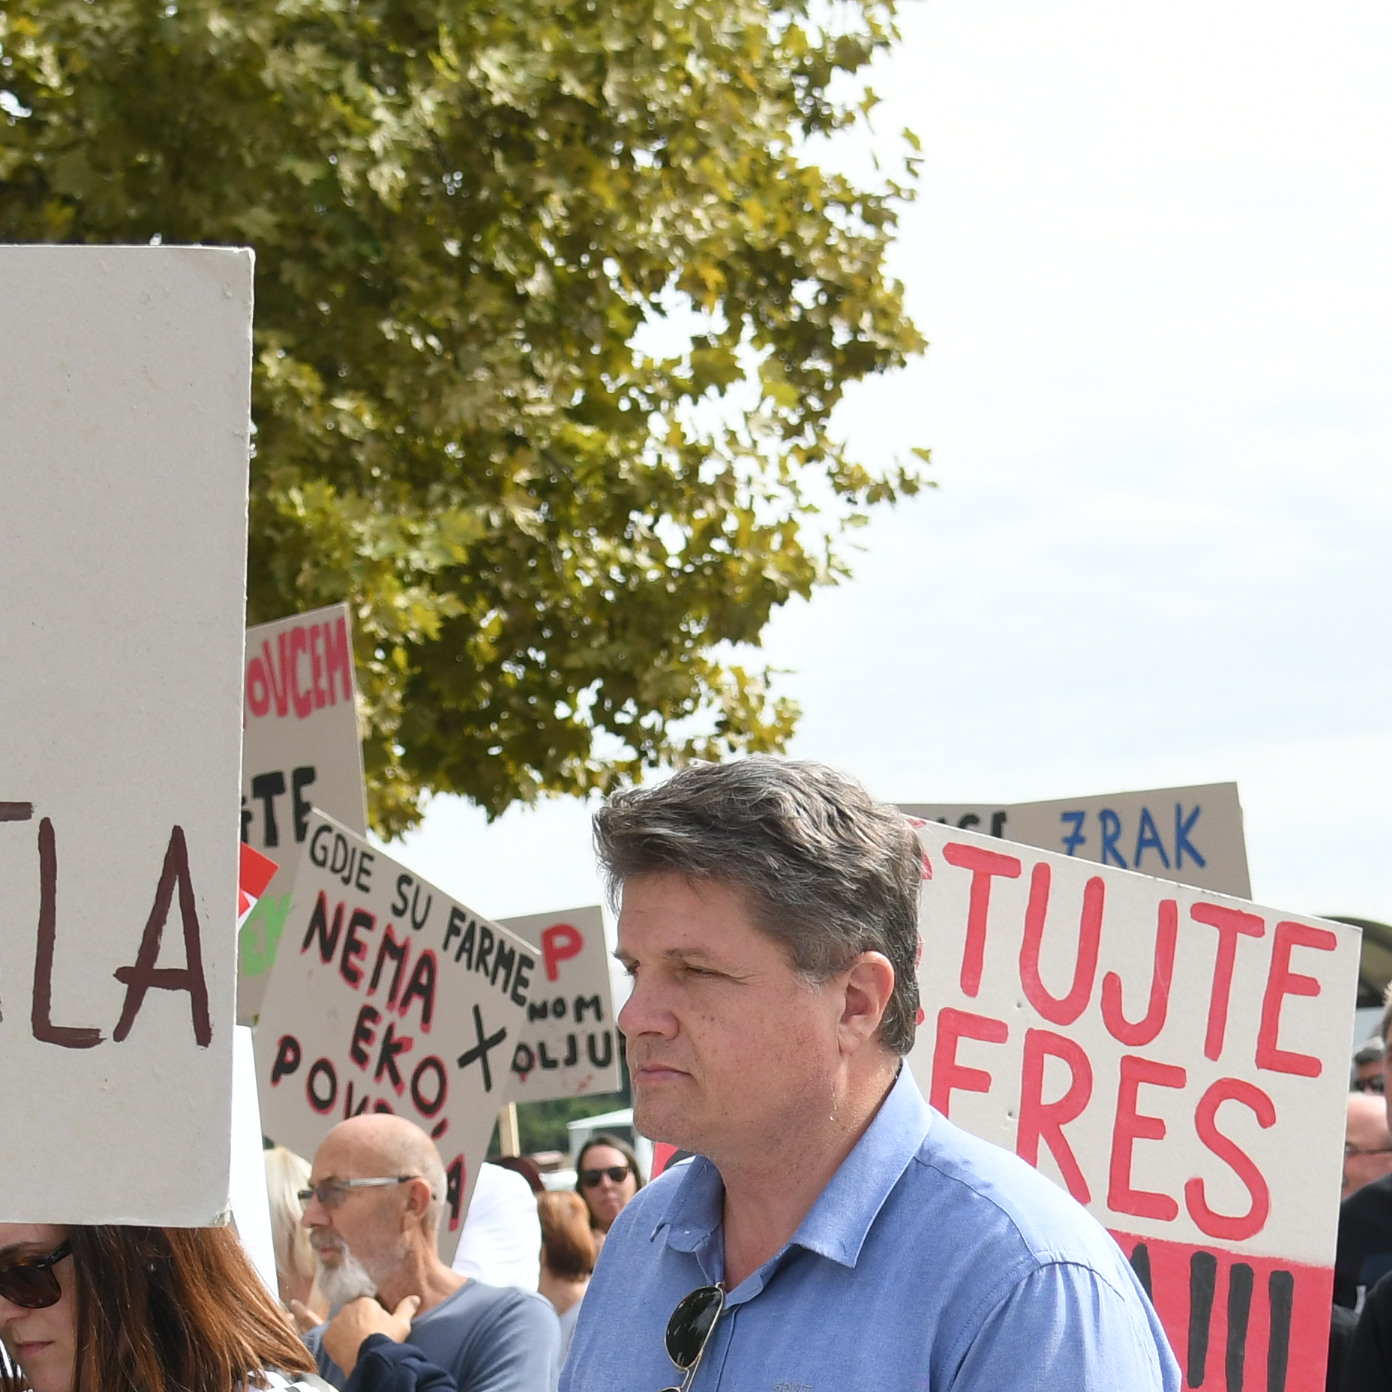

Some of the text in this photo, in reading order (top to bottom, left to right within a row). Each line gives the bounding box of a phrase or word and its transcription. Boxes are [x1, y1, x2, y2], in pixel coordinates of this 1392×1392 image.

[1060, 803, 1207, 870] ZRAK
[301, 890, 439, 1034] NEMA
[309, 824, 535, 1007] GDJE SU FARME
[349, 1004, 449, 1119] EKO
